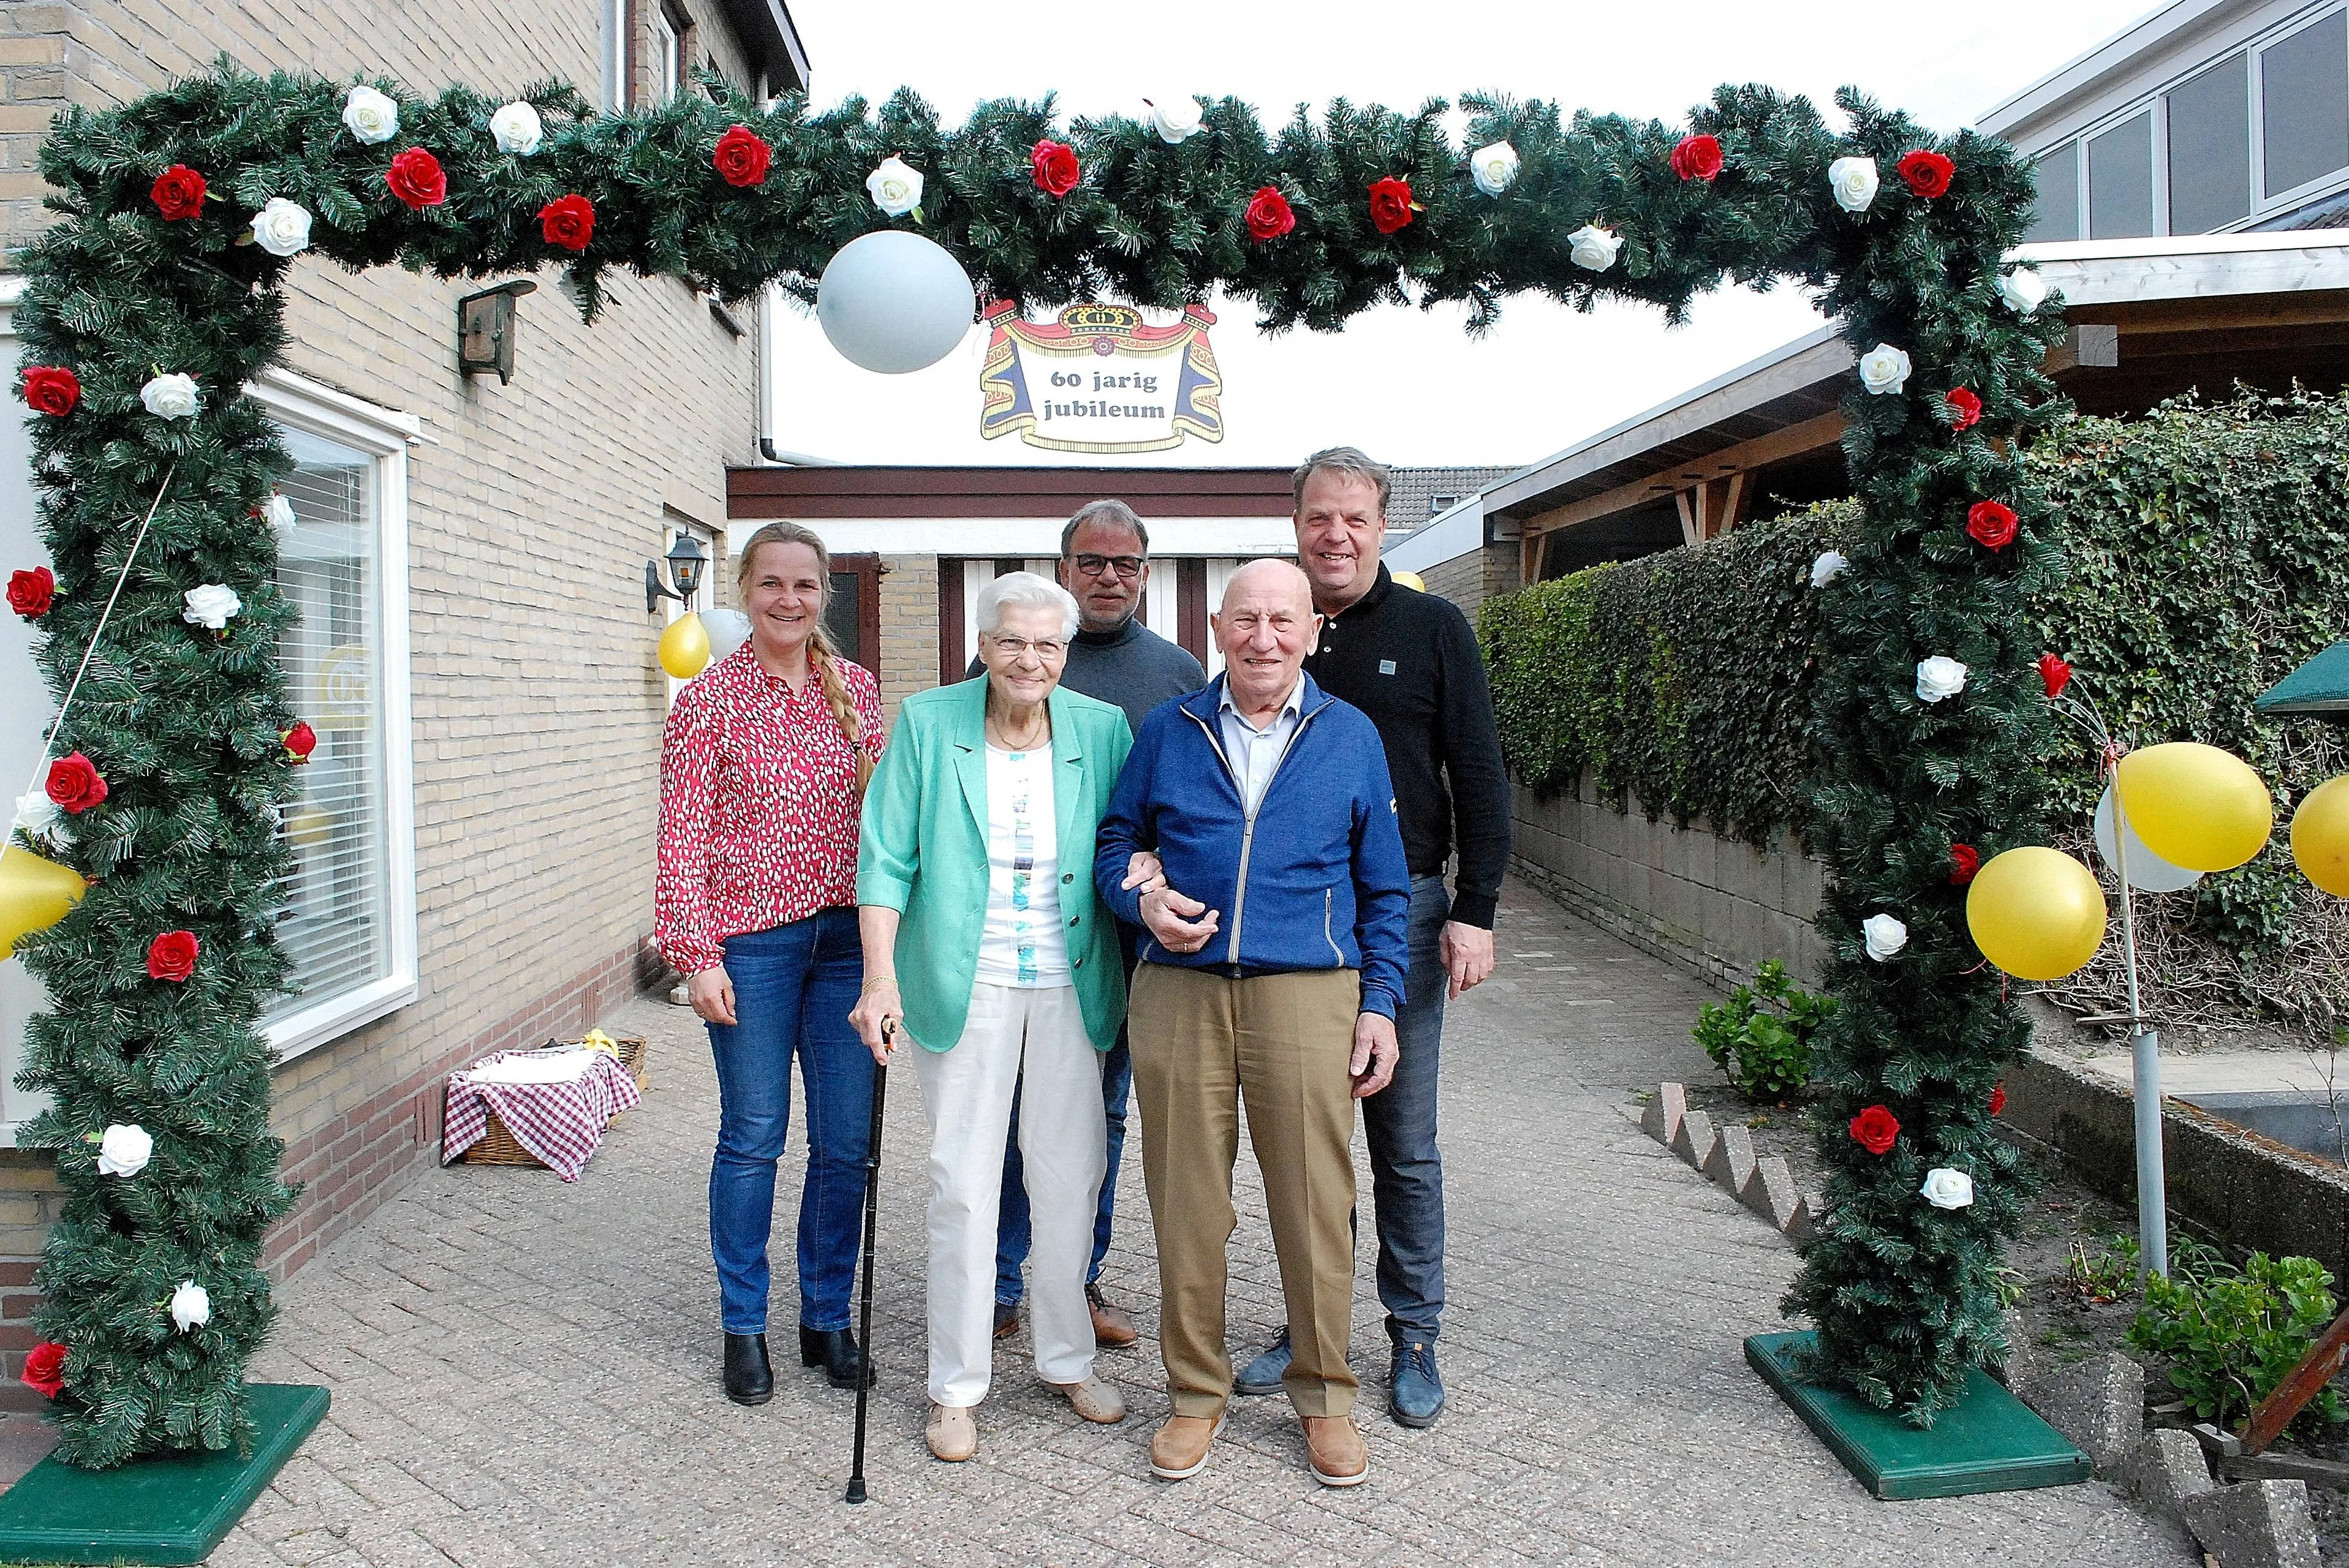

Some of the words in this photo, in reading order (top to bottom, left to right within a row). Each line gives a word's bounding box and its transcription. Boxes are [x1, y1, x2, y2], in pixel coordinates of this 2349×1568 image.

[1051, 372, 1081, 386] 60
[1093, 372, 1157, 393] jarig
[1045, 400, 1164, 420] jubileum
